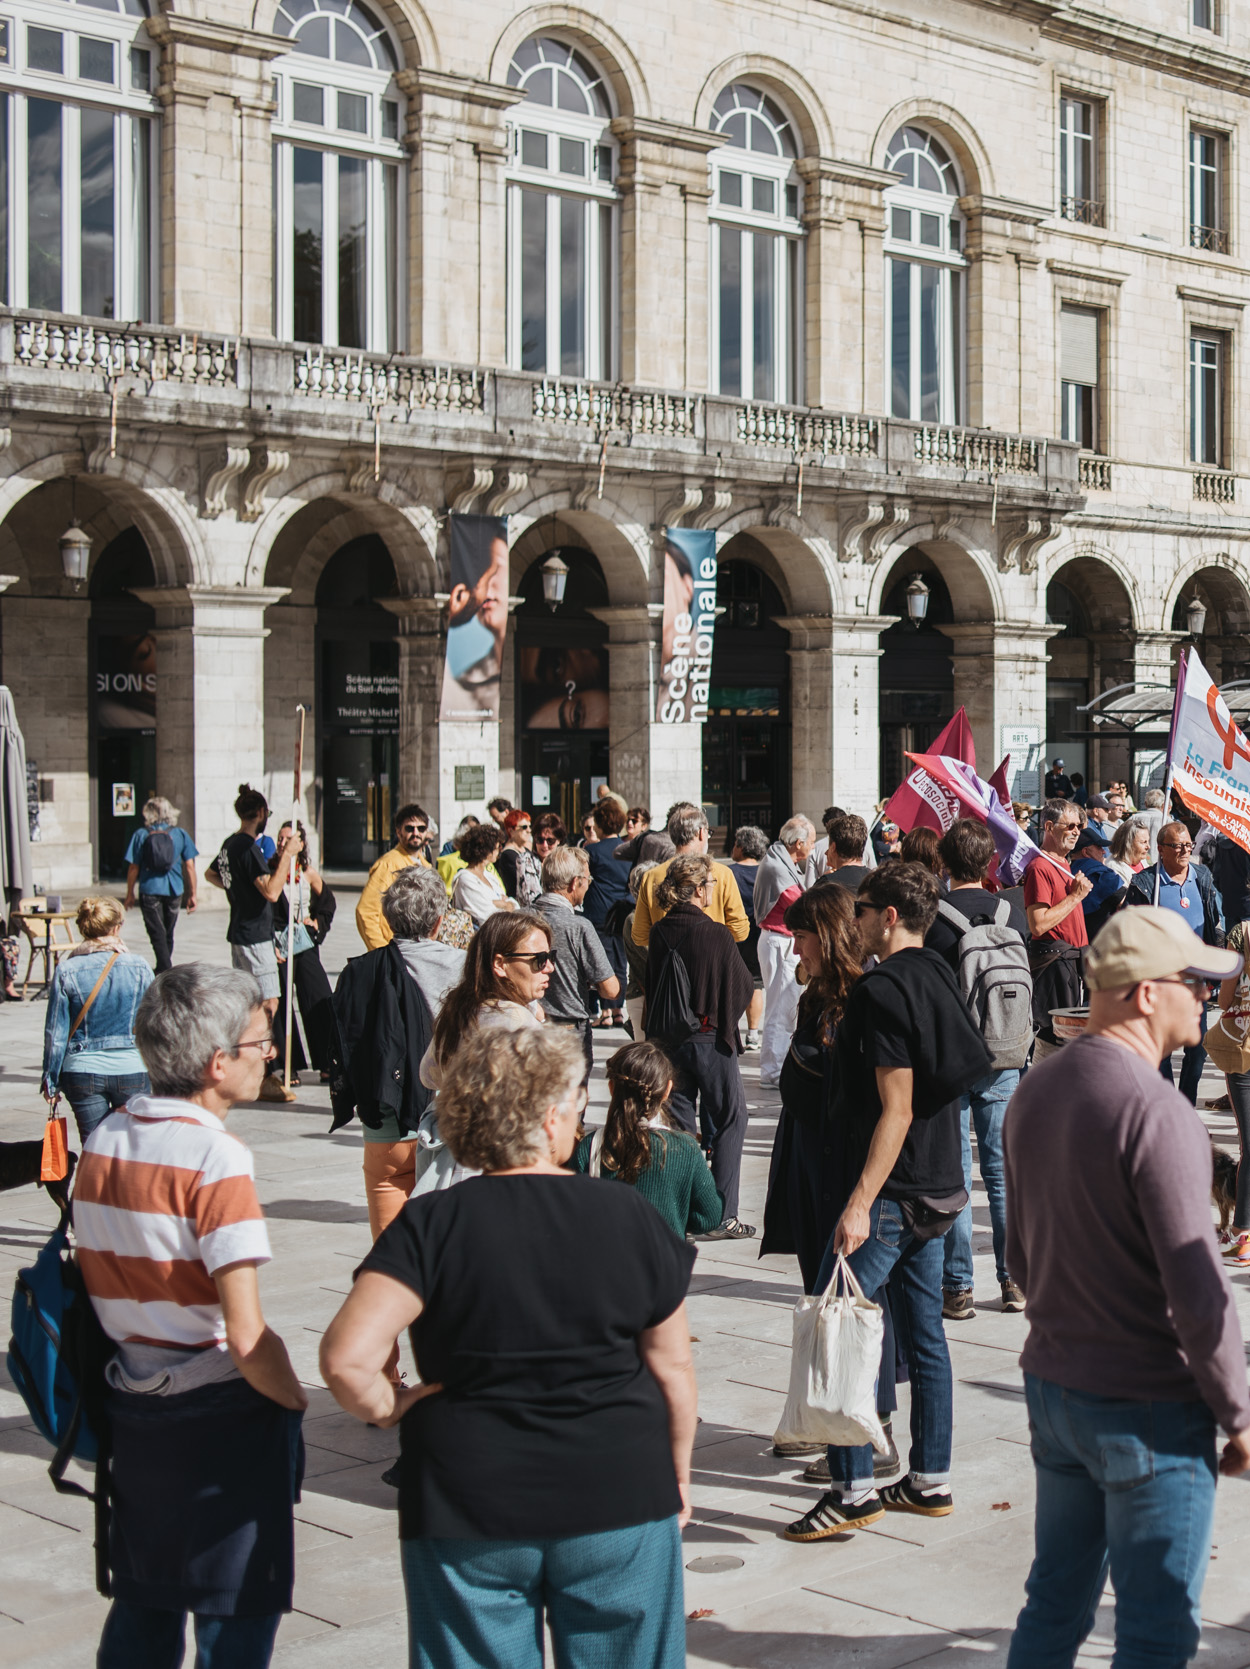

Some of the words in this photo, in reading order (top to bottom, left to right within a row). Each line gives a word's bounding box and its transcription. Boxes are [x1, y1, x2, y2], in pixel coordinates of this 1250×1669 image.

[689, 557, 717, 722] nationale
[373, 675, 400, 684] nation
[661, 612, 693, 723] Scène
[358, 685, 400, 696] Sud-Aquit
[1187, 742, 1204, 767] La
